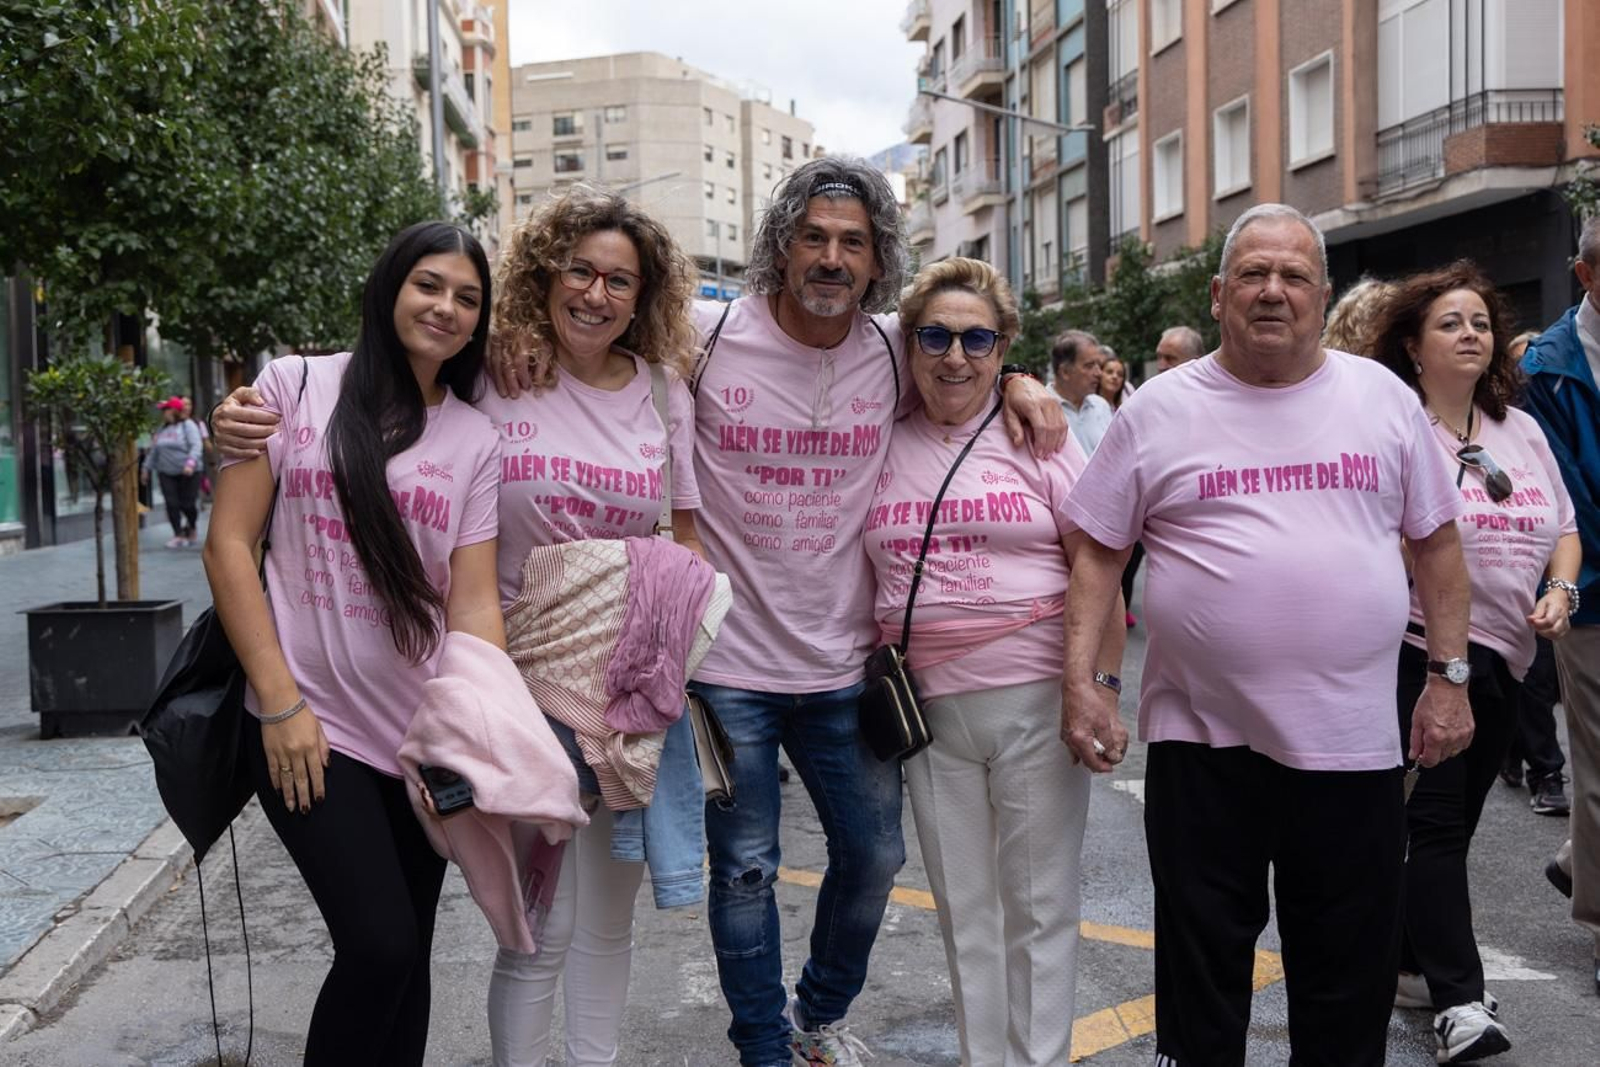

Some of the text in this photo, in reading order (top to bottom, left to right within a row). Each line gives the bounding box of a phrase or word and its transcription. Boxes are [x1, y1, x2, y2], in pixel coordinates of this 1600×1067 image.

[720, 386, 747, 405] 10
[502, 421, 530, 437] 10
[718, 419, 759, 453] JAÉN
[763, 428, 782, 454] SE
[786, 430, 829, 455] VISTE
[831, 432, 850, 456] DE
[502, 448, 546, 484] JAÉN
[551, 457, 570, 482] SE
[576, 461, 622, 493] VISTE
[626, 471, 647, 500] DE
[1198, 453, 1379, 500] JAÉN SE VISTE DE ROSA
[411, 486, 450, 533] ROSA
[744, 490, 842, 512] como paciente
[893, 501, 911, 526] SE
[962, 499, 985, 522] DE
[986, 491, 1032, 523] ROSA
[744, 510, 839, 529] como familiar
[744, 533, 836, 556] como amig@
[929, 553, 990, 578] paciente
[940, 572, 994, 593] familiar
